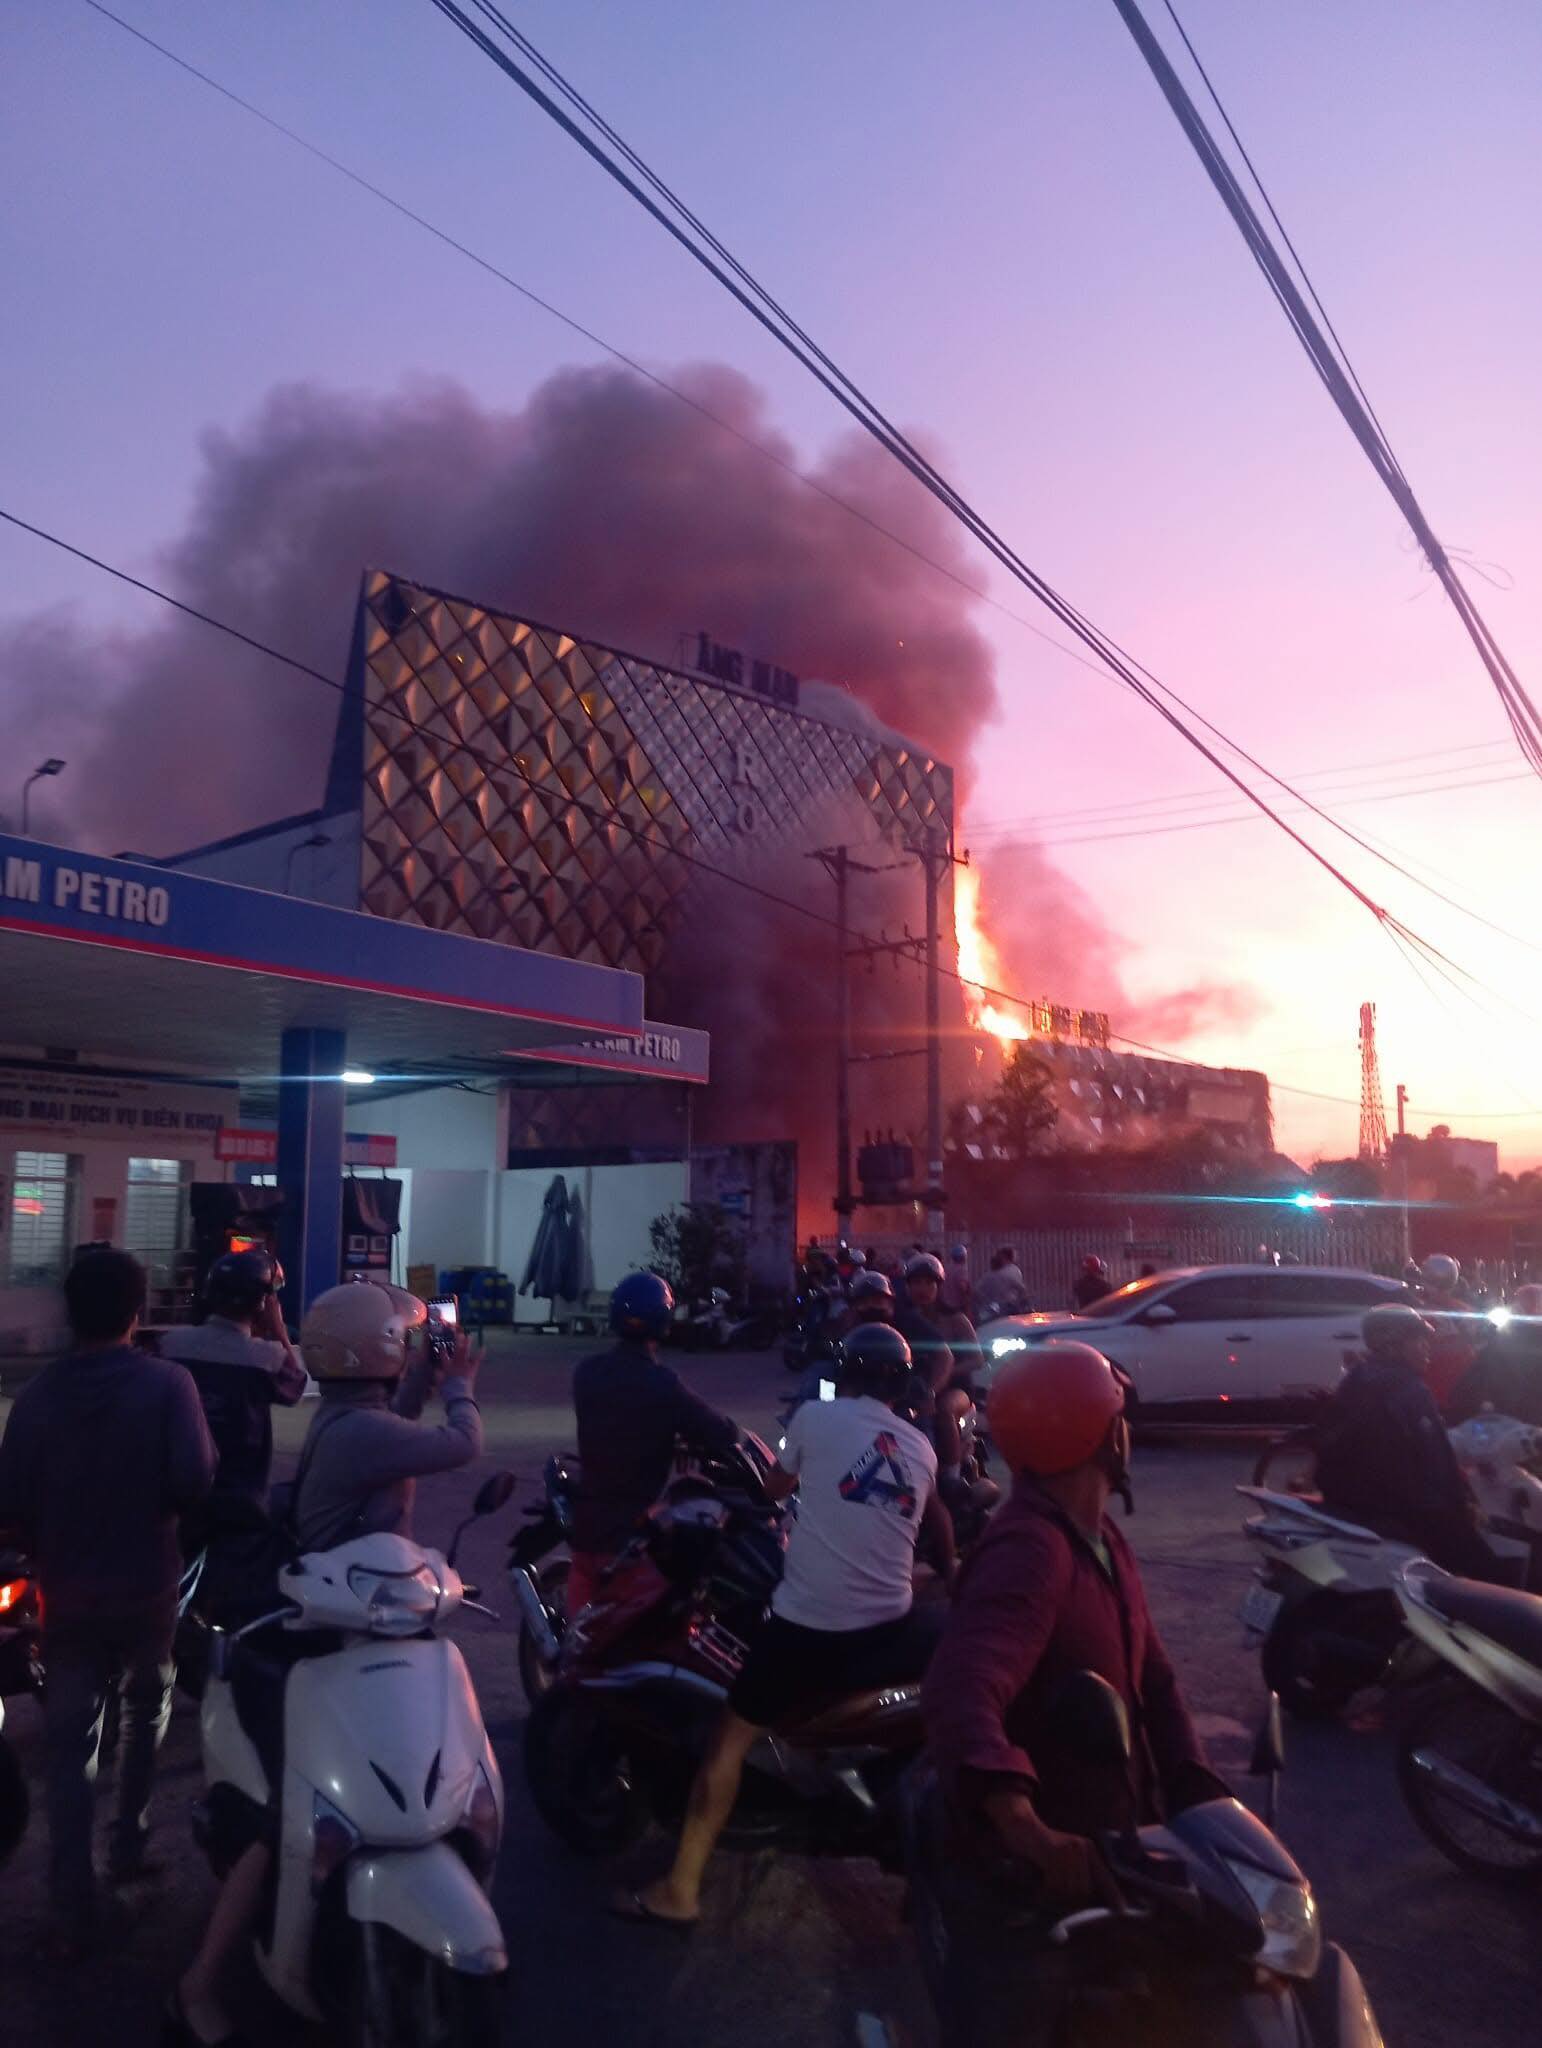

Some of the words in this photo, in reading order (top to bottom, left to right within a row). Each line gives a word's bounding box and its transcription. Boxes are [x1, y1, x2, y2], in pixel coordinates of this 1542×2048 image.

[0, 856, 41, 903] M
[54, 867, 169, 926] PETRO
[634, 1032, 681, 1061] PETRO
[70, 1103, 110, 1128] DỊCH
[115, 1107, 138, 1130] VỤ
